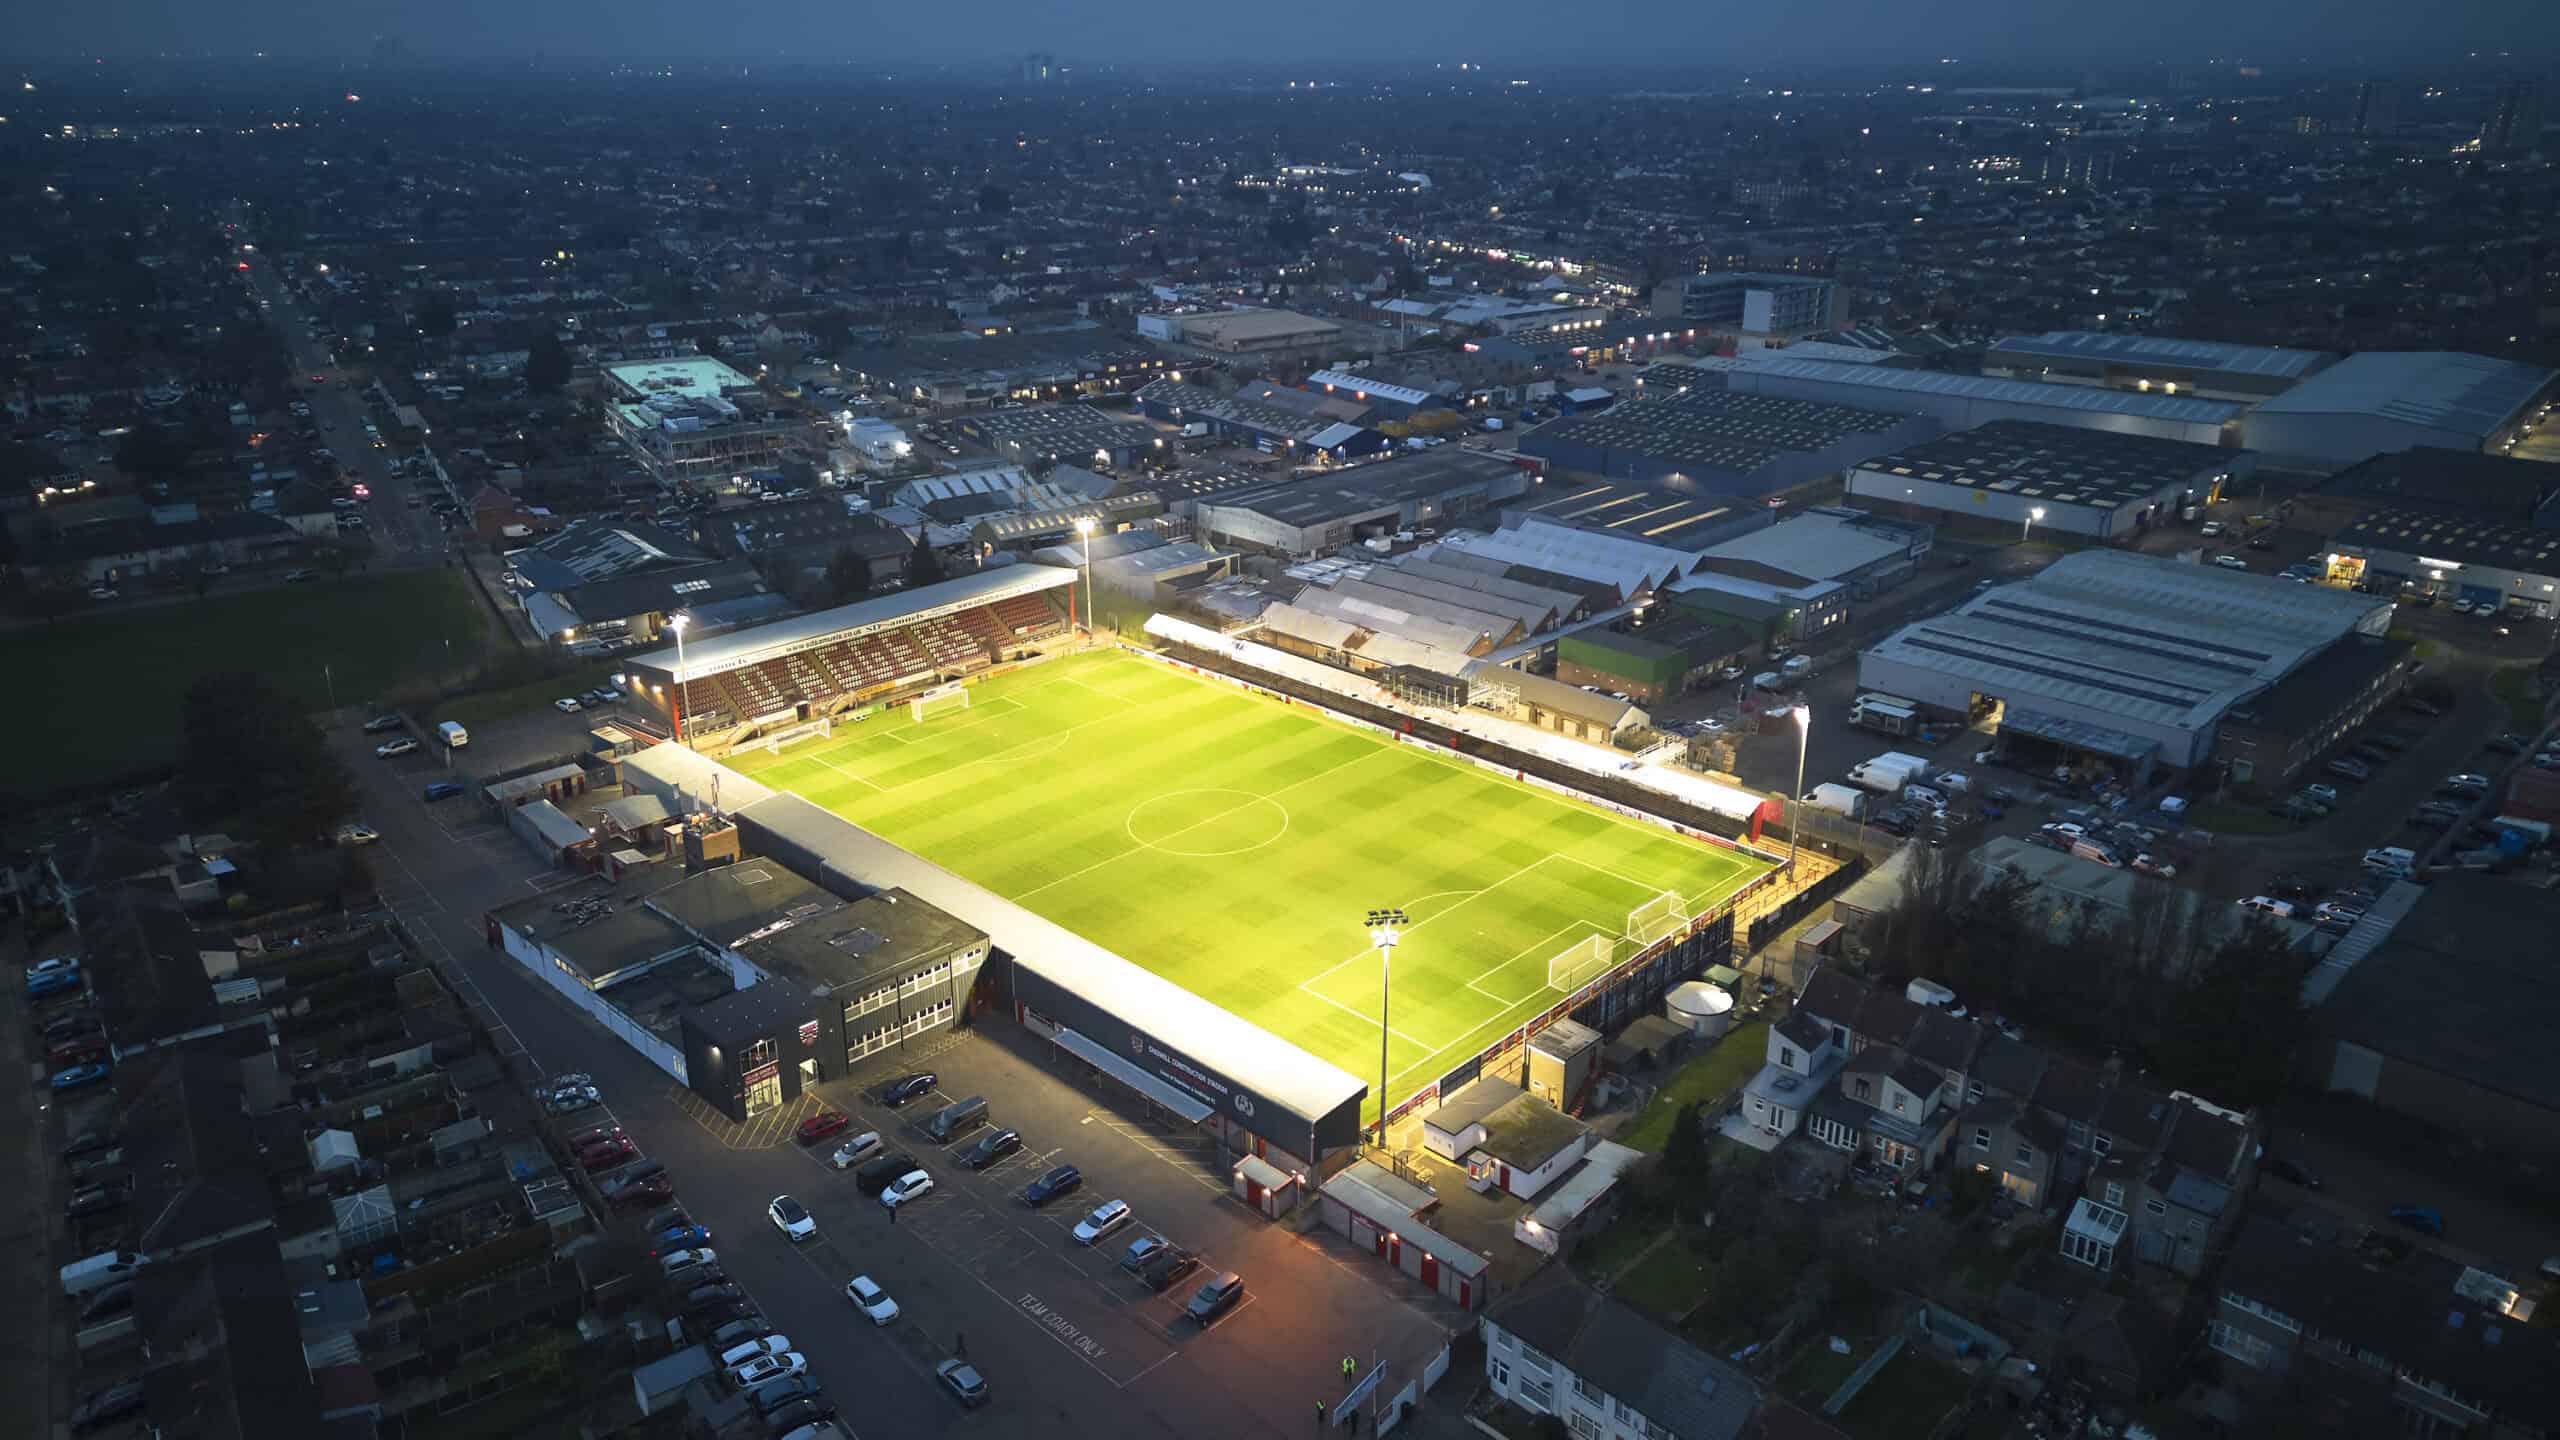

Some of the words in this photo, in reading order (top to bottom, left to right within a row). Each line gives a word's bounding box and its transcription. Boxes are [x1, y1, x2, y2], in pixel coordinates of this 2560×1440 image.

[1017, 1293, 1048, 1314] TEAM
[1042, 1312, 1080, 1338] COACH
[1074, 1335, 1108, 1358] ONLY
